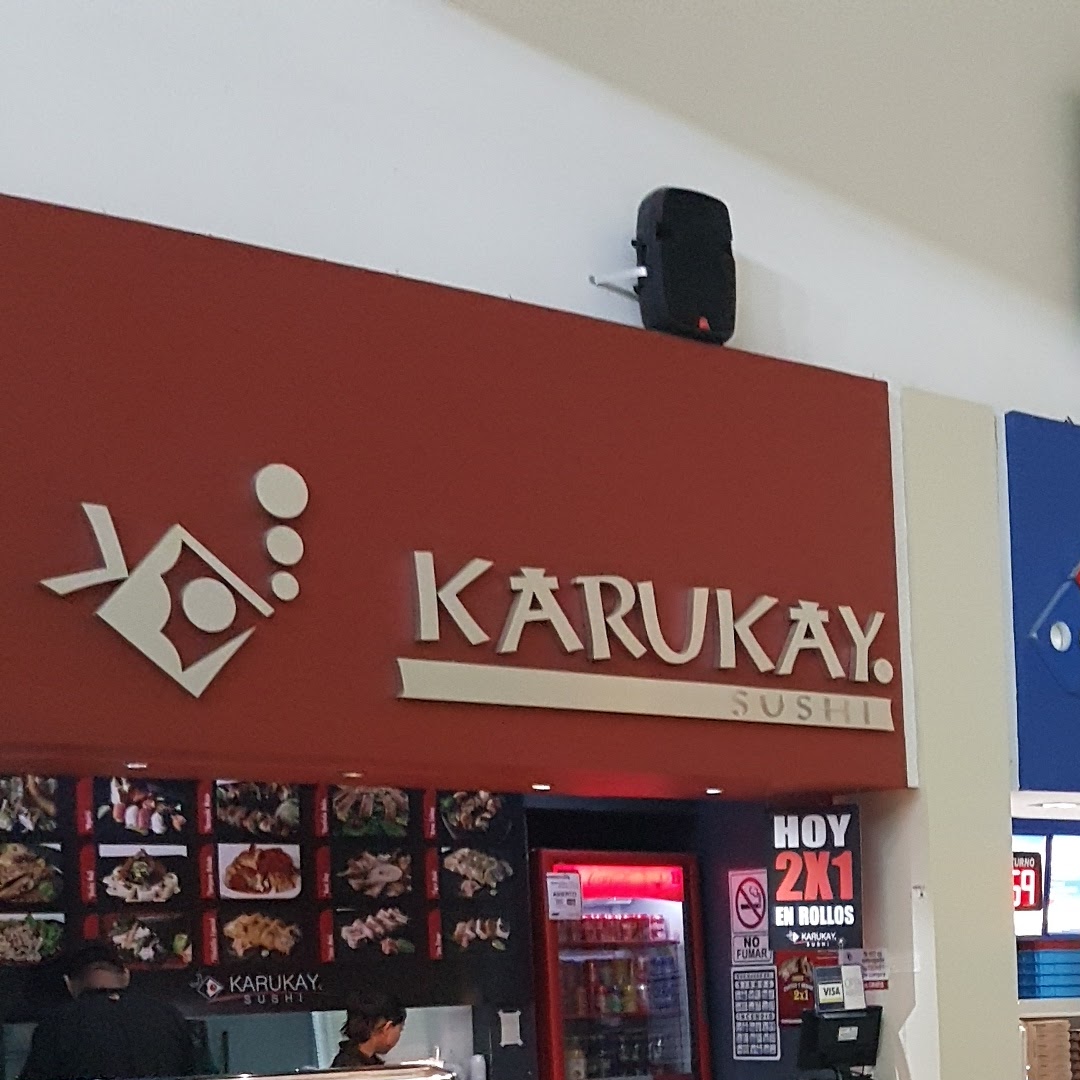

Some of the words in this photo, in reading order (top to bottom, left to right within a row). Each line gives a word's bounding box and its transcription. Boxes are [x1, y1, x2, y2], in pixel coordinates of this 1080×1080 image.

[731, 689, 873, 727] SUSHI
[774, 813, 851, 849] HOY
[775, 850, 854, 902] 2X1
[775, 905, 795, 926] EN
[798, 904, 855, 926] ROLLOS
[743, 936, 760, 948] NO
[736, 948, 768, 959] FUMAR
[793, 990, 809, 1001] 2x1
[823, 986, 841, 996] VISA
[243, 992, 304, 1005] SUSHI
